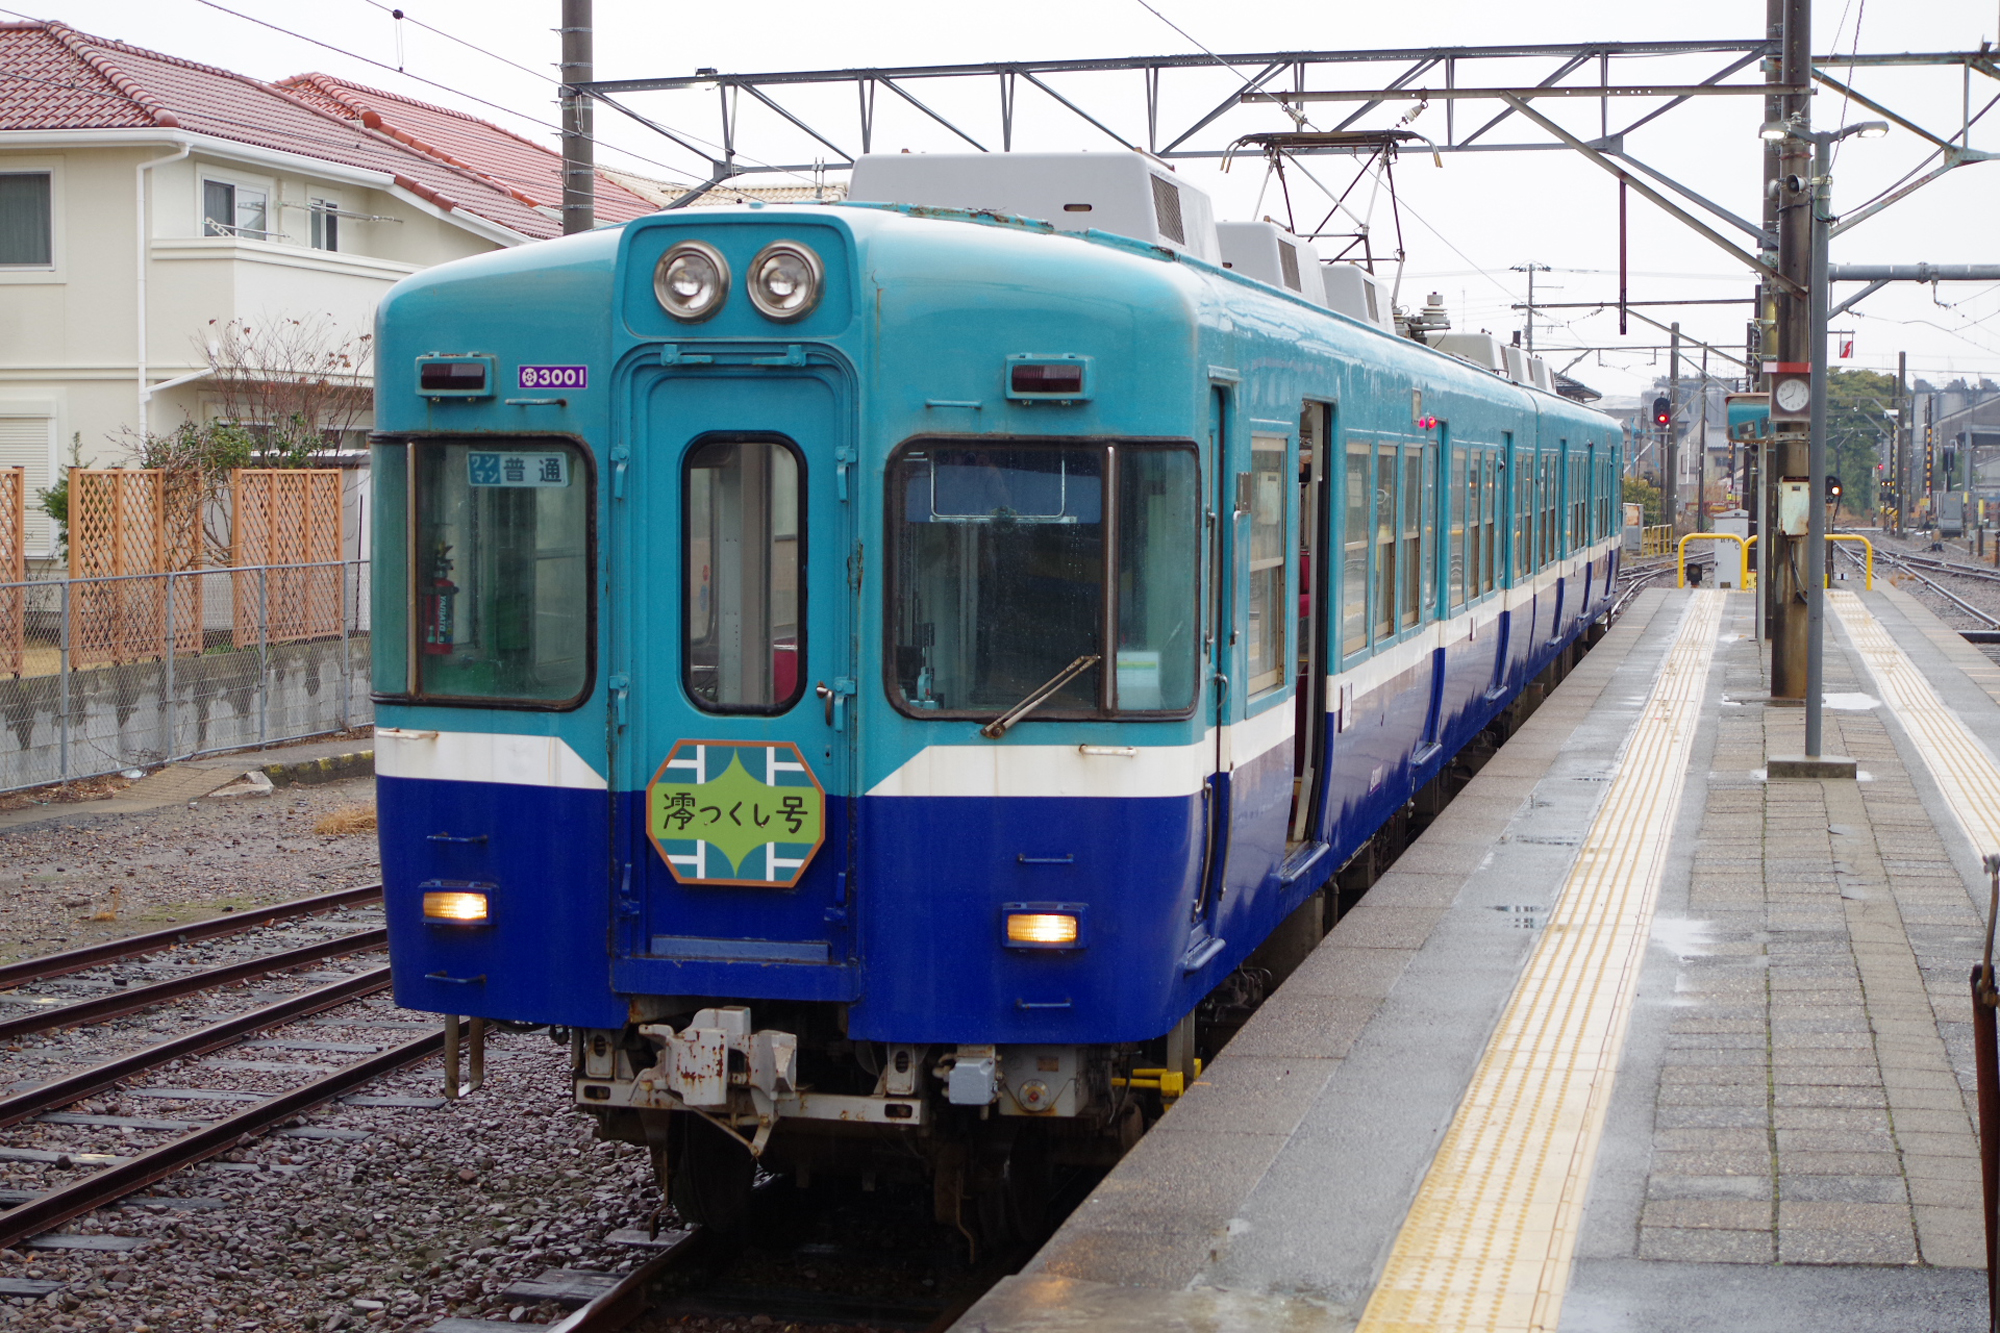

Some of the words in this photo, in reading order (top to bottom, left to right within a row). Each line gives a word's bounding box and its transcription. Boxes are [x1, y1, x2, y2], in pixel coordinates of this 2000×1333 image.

[538, 369, 584, 386] 3001
[471, 456, 495, 468] ワン
[504, 457, 562, 482] 普通
[475, 471, 498, 483] マン
[663, 791, 809, 834] 澪つくし号
